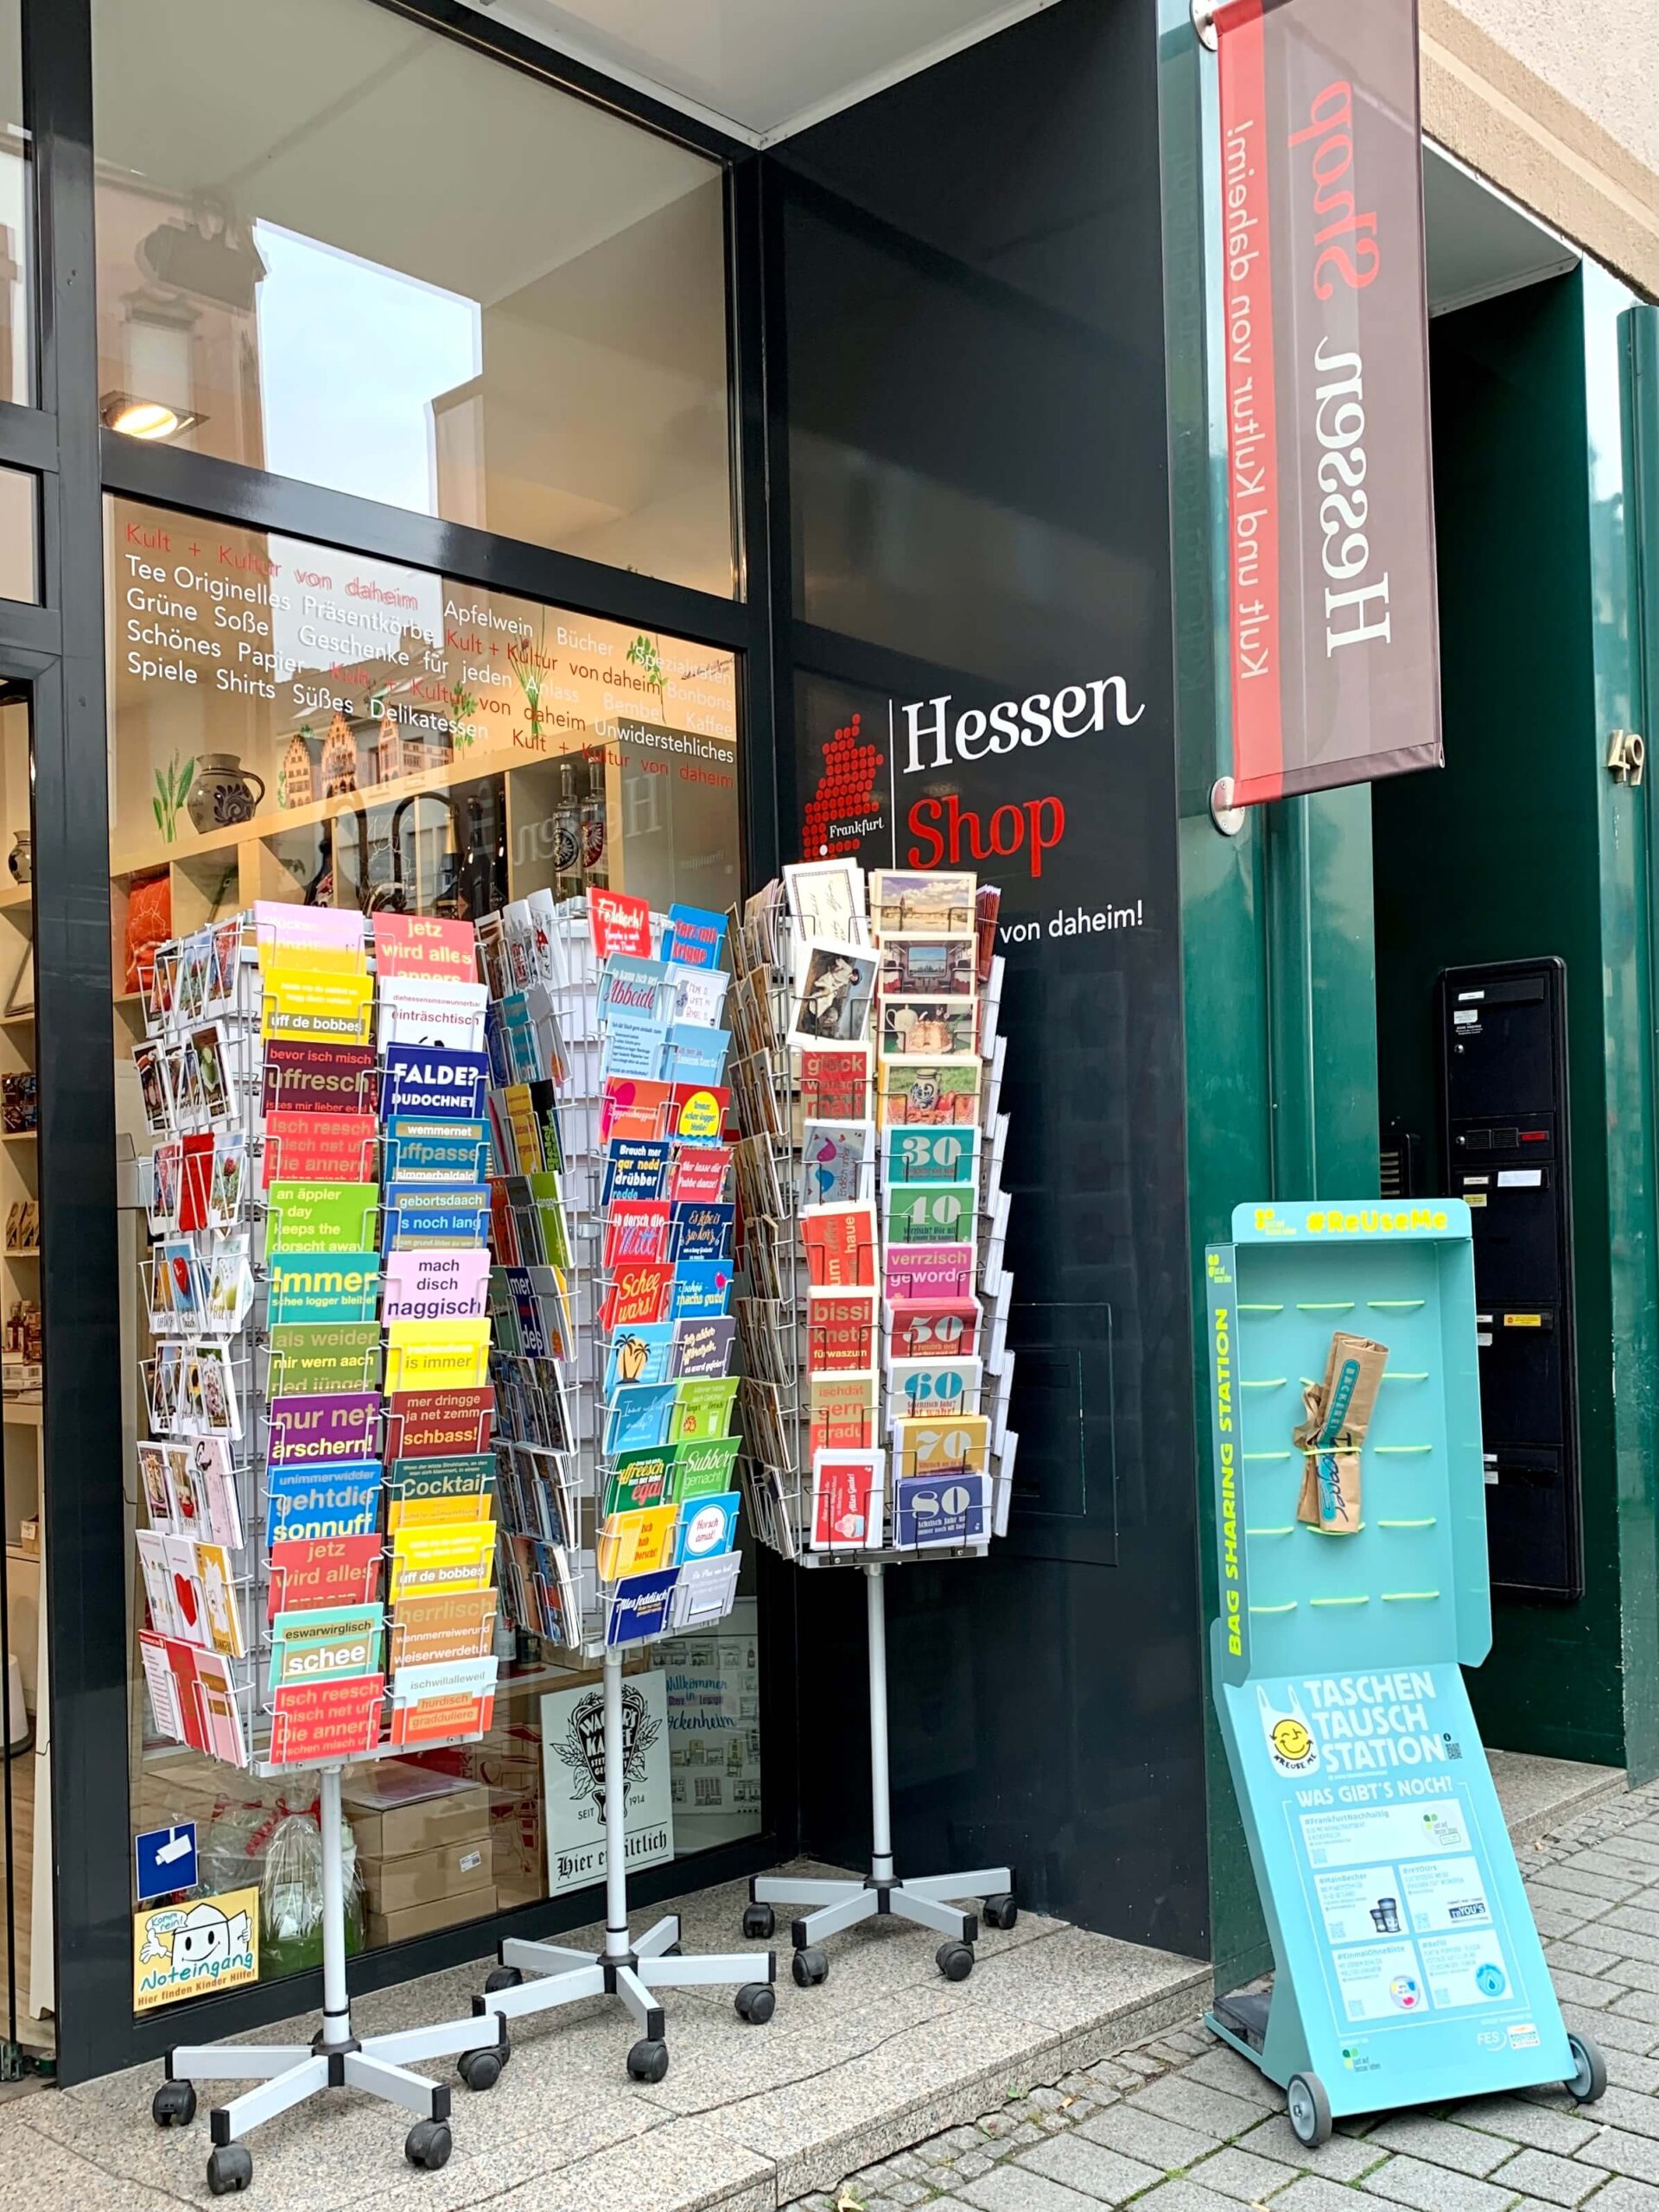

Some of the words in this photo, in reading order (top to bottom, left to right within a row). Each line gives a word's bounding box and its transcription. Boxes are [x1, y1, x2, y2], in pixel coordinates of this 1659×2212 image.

[127, 524, 171, 552] Kult
[219, 545, 282, 577] Kultur
[294, 569, 332, 589] von
[345, 577, 418, 610] daheim
[443, 600, 534, 638] Apfelwein
[556, 626, 614, 658] Bücher
[125, 554, 166, 583] Tee
[174, 566, 291, 611] Originelles
[302, 595, 435, 643] Präsentkörbe
[446, 630, 482, 655] Kult
[507, 645, 558, 671] Kultur
[569, 662, 598, 681] von
[602, 664, 662, 696] daheim
[666, 681, 733, 714] Bonbons
[127, 588, 198, 621] Grüne
[214, 607, 269, 635] Soße
[299, 625, 410, 666] Geschenke
[423, 652, 448, 675] für
[461, 660, 512, 690] jeden
[525, 676, 580, 703] Anlass
[684, 712, 733, 735] Kaffee
[128, 620, 221, 658] Schönes
[238, 641, 304, 673] Papier
[330, 661, 369, 684] Kult
[479, 698, 512, 715] von
[524, 706, 586, 732] daheim
[594, 720, 734, 763] Unwiderstehliches
[128, 652, 198, 683] Spiele
[216, 668, 276, 699] Shirts
[293, 683, 353, 714] Süßes
[370, 699, 488, 741] Delikatessen
[512, 728, 546, 753] Kult
[582, 742, 630, 768] Kultur
[640, 759, 669, 775] von
[679, 765, 734, 789] daheim
[901, 675, 1146, 775] Hessen
[829, 816, 885, 840] Frankfurt
[907, 793, 1065, 879] Shop
[407, 918, 442, 938] jetz
[999, 918, 1040, 944] von
[1048, 899, 1144, 938] daheim!
[381, 943, 423, 959] wird
[429, 944, 473, 963] alles
[293, 1015, 309, 1029] de
[313, 1017, 362, 1033] bobbes
[391, 1008, 480, 1026] einträschtisch
[270, 1048, 304, 1060] bevor
[308, 1048, 333, 1062] isch
[336, 1051, 372, 1065] misch
[268, 1068, 370, 1093] uffresch
[393, 1063, 480, 1086] FALDE?
[391, 1093, 475, 1108] DUDOCHNET
[408, 1125, 472, 1137] wemmernet
[399, 1142, 480, 1164] uffpasse
[620, 1144, 646, 1156] Brauch
[902, 1135, 962, 1166] 30
[618, 1160, 633, 1170] gar
[637, 1160, 659, 1170] nedd
[615, 1173, 658, 1186] drübber
[276, 1188, 294, 1200] an
[297, 1187, 341, 1205] äppler
[399, 1194, 483, 1209] gebortsdaach
[287, 1206, 313, 1220] day
[900, 1195, 962, 1224] 40
[1306, 1209, 1447, 1232] #ReUseMe
[319, 1223, 340, 1235] the
[413, 1216, 448, 1230] noch
[452, 1217, 481, 1230] lang
[845, 1216, 856, 1253] haue
[418, 1259, 460, 1272] mach
[891, 1251, 967, 1265] verrzisch
[272, 1267, 378, 1293] Immer
[416, 1278, 459, 1290] disch
[510, 1278, 531, 1295] mer
[890, 1269, 967, 1287] geworde
[306, 1296, 339, 1307] logger
[388, 1298, 481, 1319] naggisch
[813, 1301, 869, 1321] bissi
[276, 1332, 304, 1347] als
[311, 1330, 376, 1345] weider
[813, 1326, 868, 1343] knete
[902, 1315, 963, 1343] 50
[302, 1357, 336, 1368] wern
[340, 1354, 374, 1367] aach
[405, 1356, 419, 1369] is
[423, 1356, 472, 1369] immer
[1215, 1307, 1233, 1433] STATION
[904, 1371, 963, 1401] 60
[407, 1397, 432, 1408] mer
[435, 1395, 481, 1408] dringge
[276, 1408, 324, 1430] nur
[331, 1403, 376, 1427] net
[405, 1411, 418, 1423] ja
[421, 1411, 441, 1421] net
[272, 1435, 373, 1459] ärschern!
[404, 1427, 478, 1445] schbass!
[916, 1430, 972, 1460] 70
[685, 1447, 730, 1473] Subber
[402, 1474, 487, 1497] Cocktail
[276, 1485, 374, 1516] gehtdie
[912, 1485, 970, 1520] 80
[1220, 1441, 1239, 1580] SHARING
[273, 1513, 372, 1541] sonnuff
[307, 1541, 346, 1563] jetz
[285, 1621, 372, 1639] eswarwirglisch
[1227, 1589, 1242, 1656] BAG
[289, 1645, 366, 1674] schee
[410, 1672, 486, 1690] ischwillalleweil
[1303, 1672, 1437, 1709] TASCHEN
[280, 1689, 318, 1706] Isch
[322, 1681, 380, 1700] reesch
[328, 1705, 353, 1716] net
[1312, 1703, 1429, 1740] TAUSCH
[1321, 1733, 1447, 1773] STATION
[629, 1795, 645, 1806] 1914
[1296, 1789, 1334, 1808] WAS
[1338, 1782, 1394, 1803] GIBT'S
[1397, 1776, 1453, 1796] NOCH?
[578, 1808, 594, 1820] SEIT
[557, 1854, 593, 1880] Hier
[151, 1913, 178, 1927] Komm
[160, 1918, 186, 1931] rein!
[140, 1952, 254, 1993] Noteingang
[138, 1995, 158, 2006] Hier
[162, 1986, 193, 2000] finden
[195, 1977, 227, 1992] Kinder
[230, 1968, 256, 1984] Hilfe!
[1477, 2032, 1500, 2045] FES
